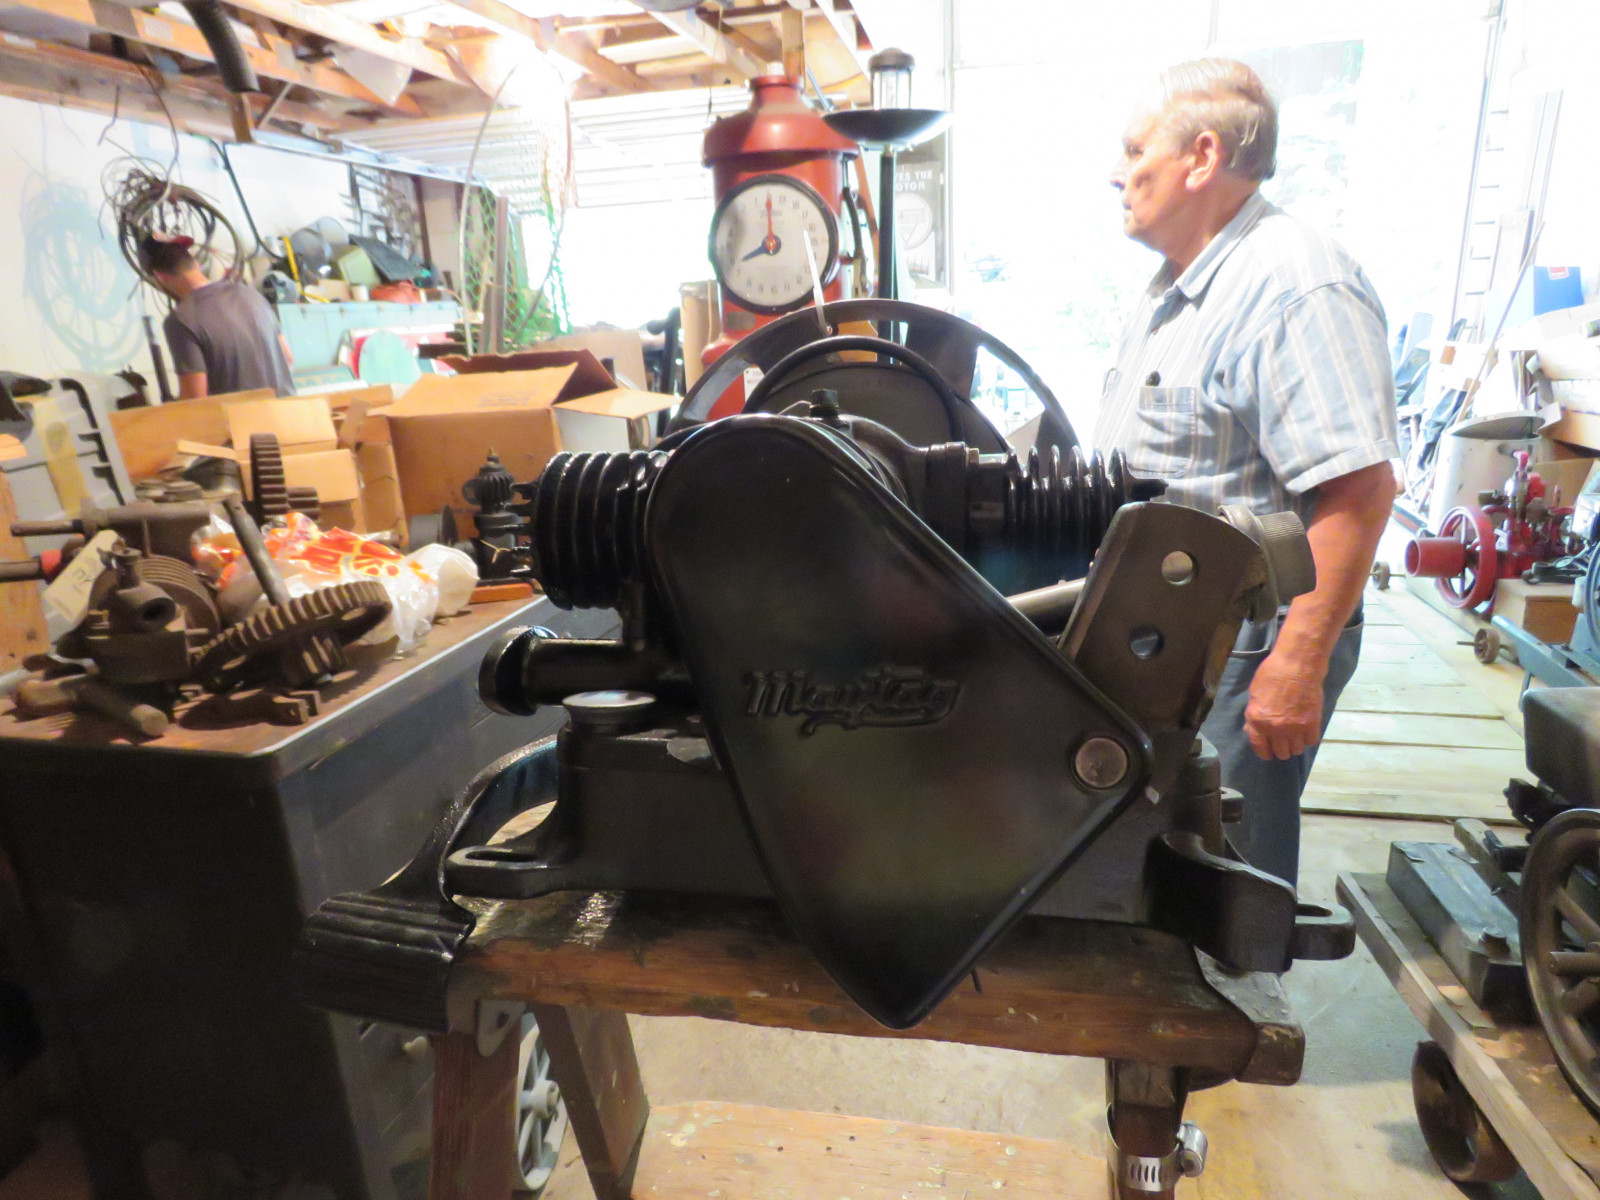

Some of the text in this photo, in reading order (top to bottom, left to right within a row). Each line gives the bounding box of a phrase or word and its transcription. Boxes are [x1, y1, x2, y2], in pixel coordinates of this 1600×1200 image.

[914, 170, 933, 180] THE
[895, 180, 926, 191] OTOR
[742, 666, 962, 738] Maytag
